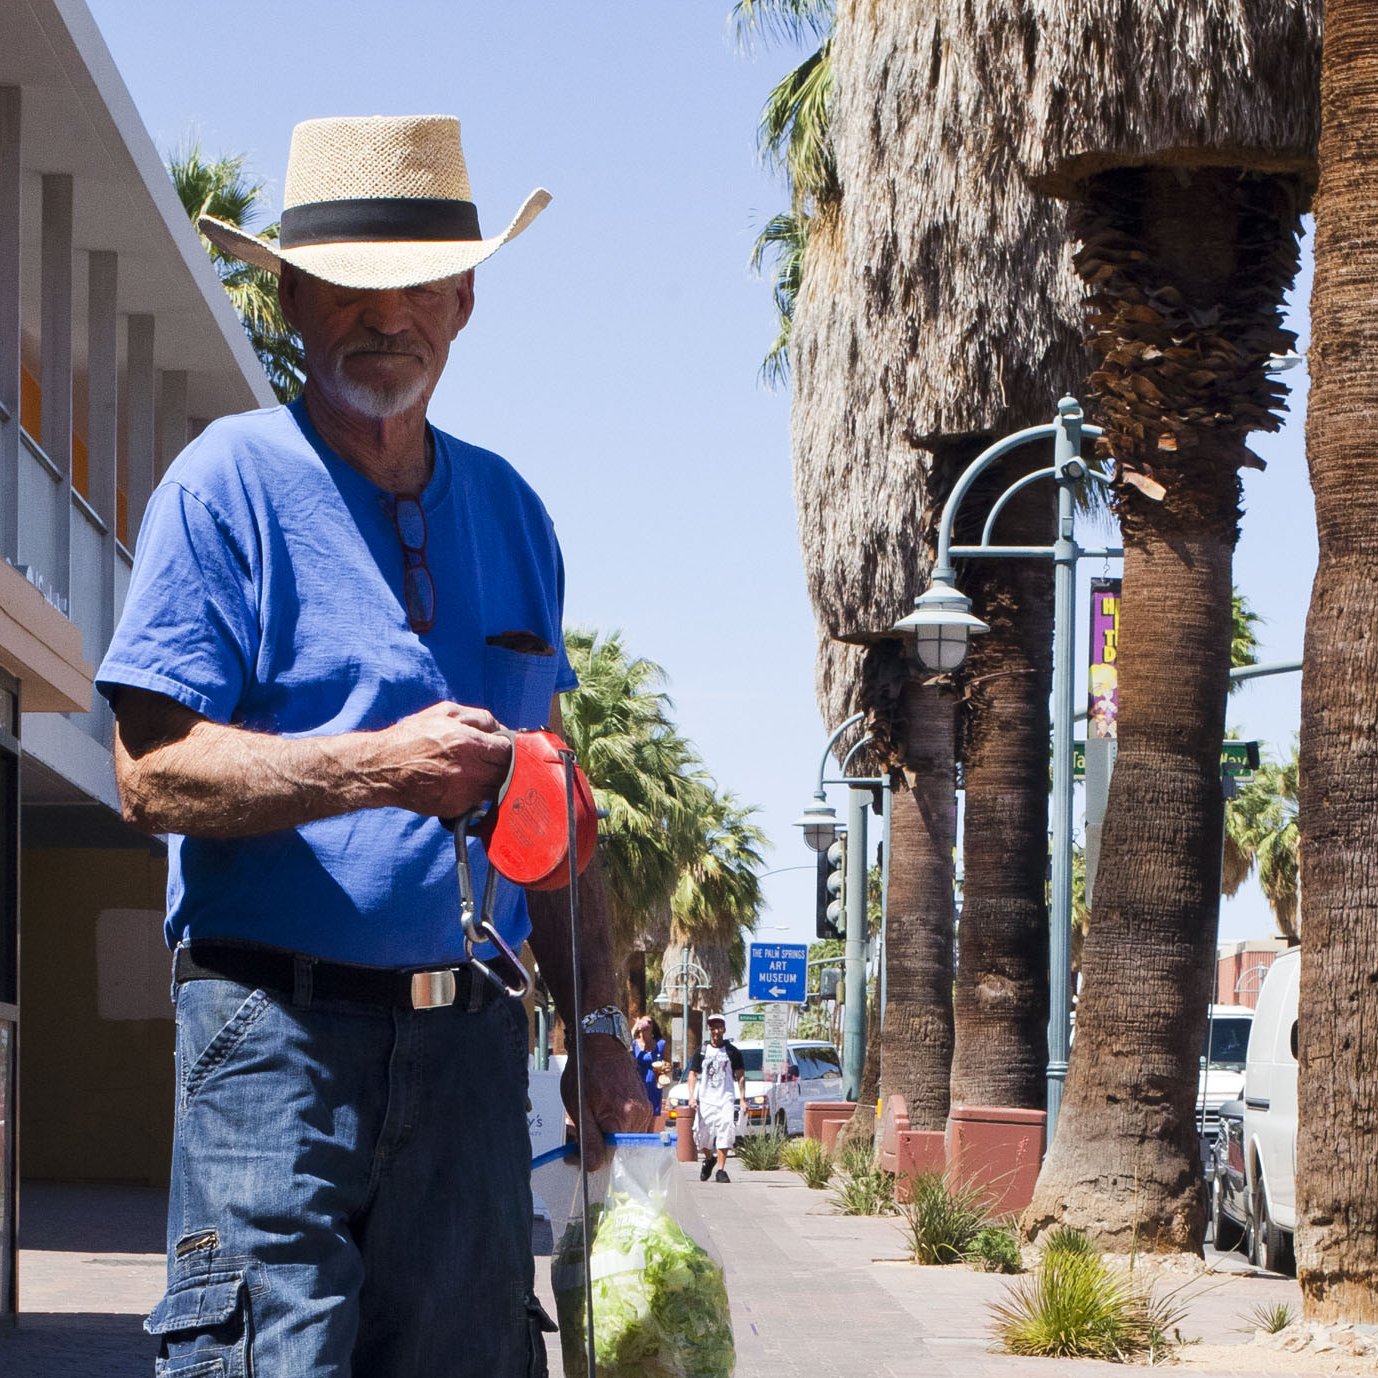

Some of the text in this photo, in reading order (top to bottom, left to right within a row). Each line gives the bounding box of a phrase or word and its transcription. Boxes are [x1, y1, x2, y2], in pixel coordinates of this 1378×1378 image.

[752, 949, 806, 960] THE PALM SPRINGS
[769, 961, 787, 971] ART
[759, 973, 797, 983] MUSEUM
